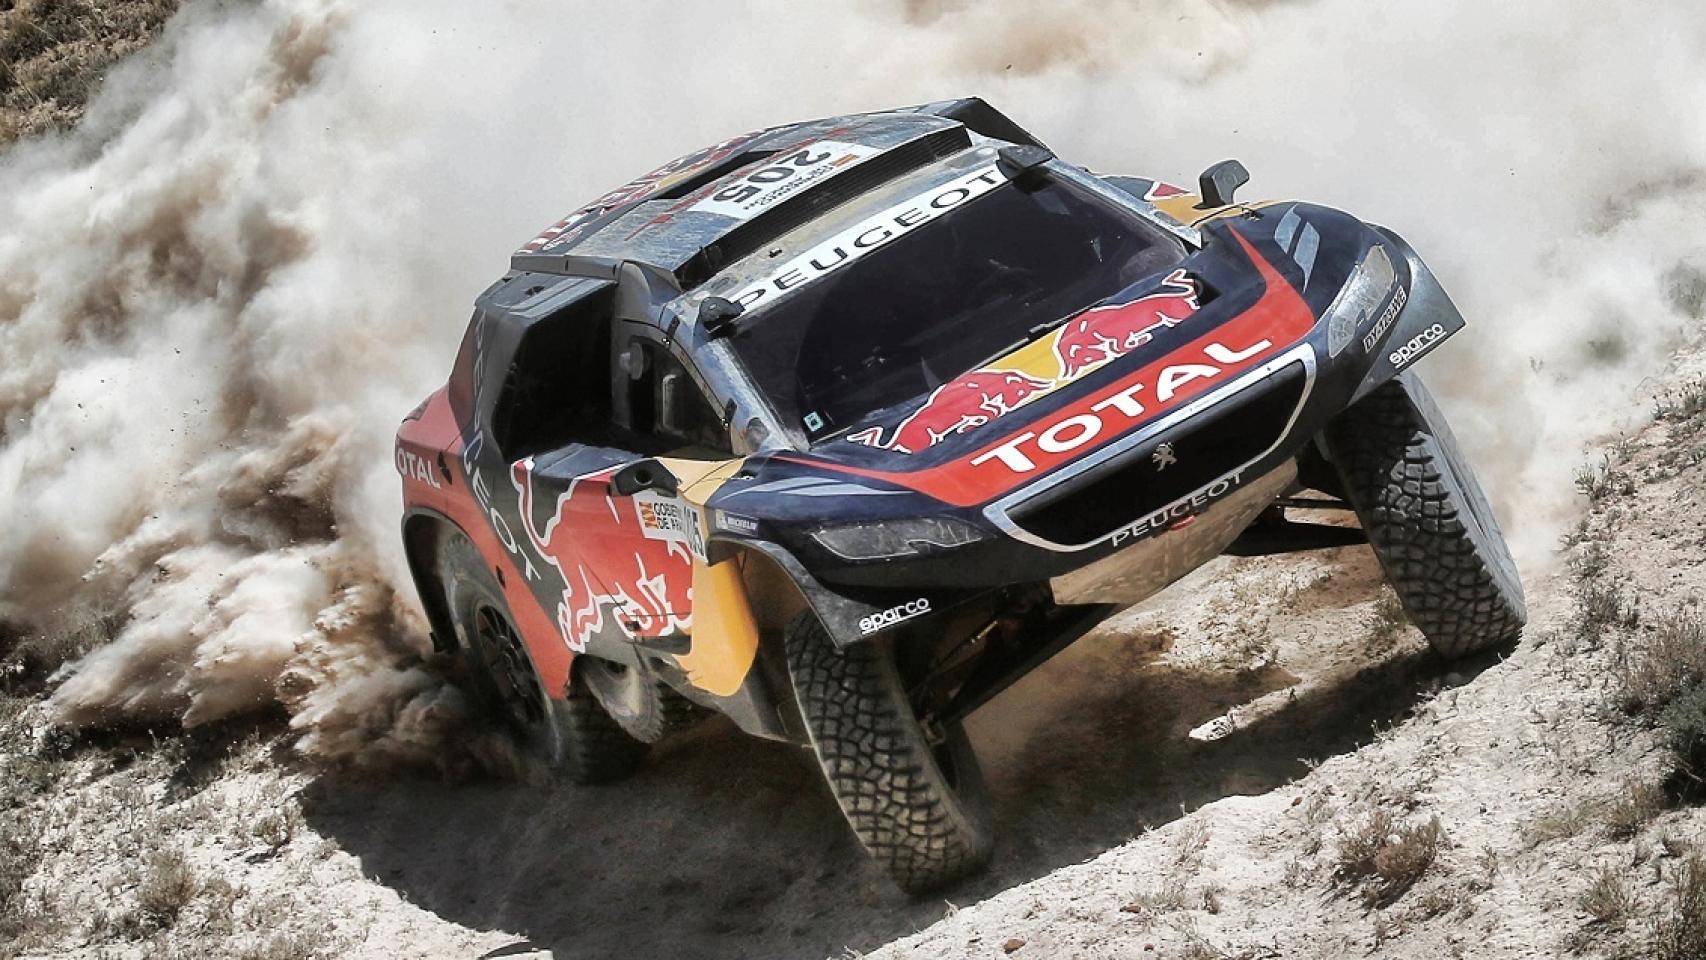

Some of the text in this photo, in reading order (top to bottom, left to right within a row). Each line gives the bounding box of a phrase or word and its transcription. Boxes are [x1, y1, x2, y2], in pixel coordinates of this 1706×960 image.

[713, 150, 832, 203] 205
[736, 169, 998, 312] PEUGEOT
[1388, 323, 1445, 365] sparco
[970, 338, 1273, 473] TOTAL
[397, 447, 441, 489] OTAL
[1110, 469, 1246, 548] PEUGEOT
[858, 597, 930, 632] sparco
